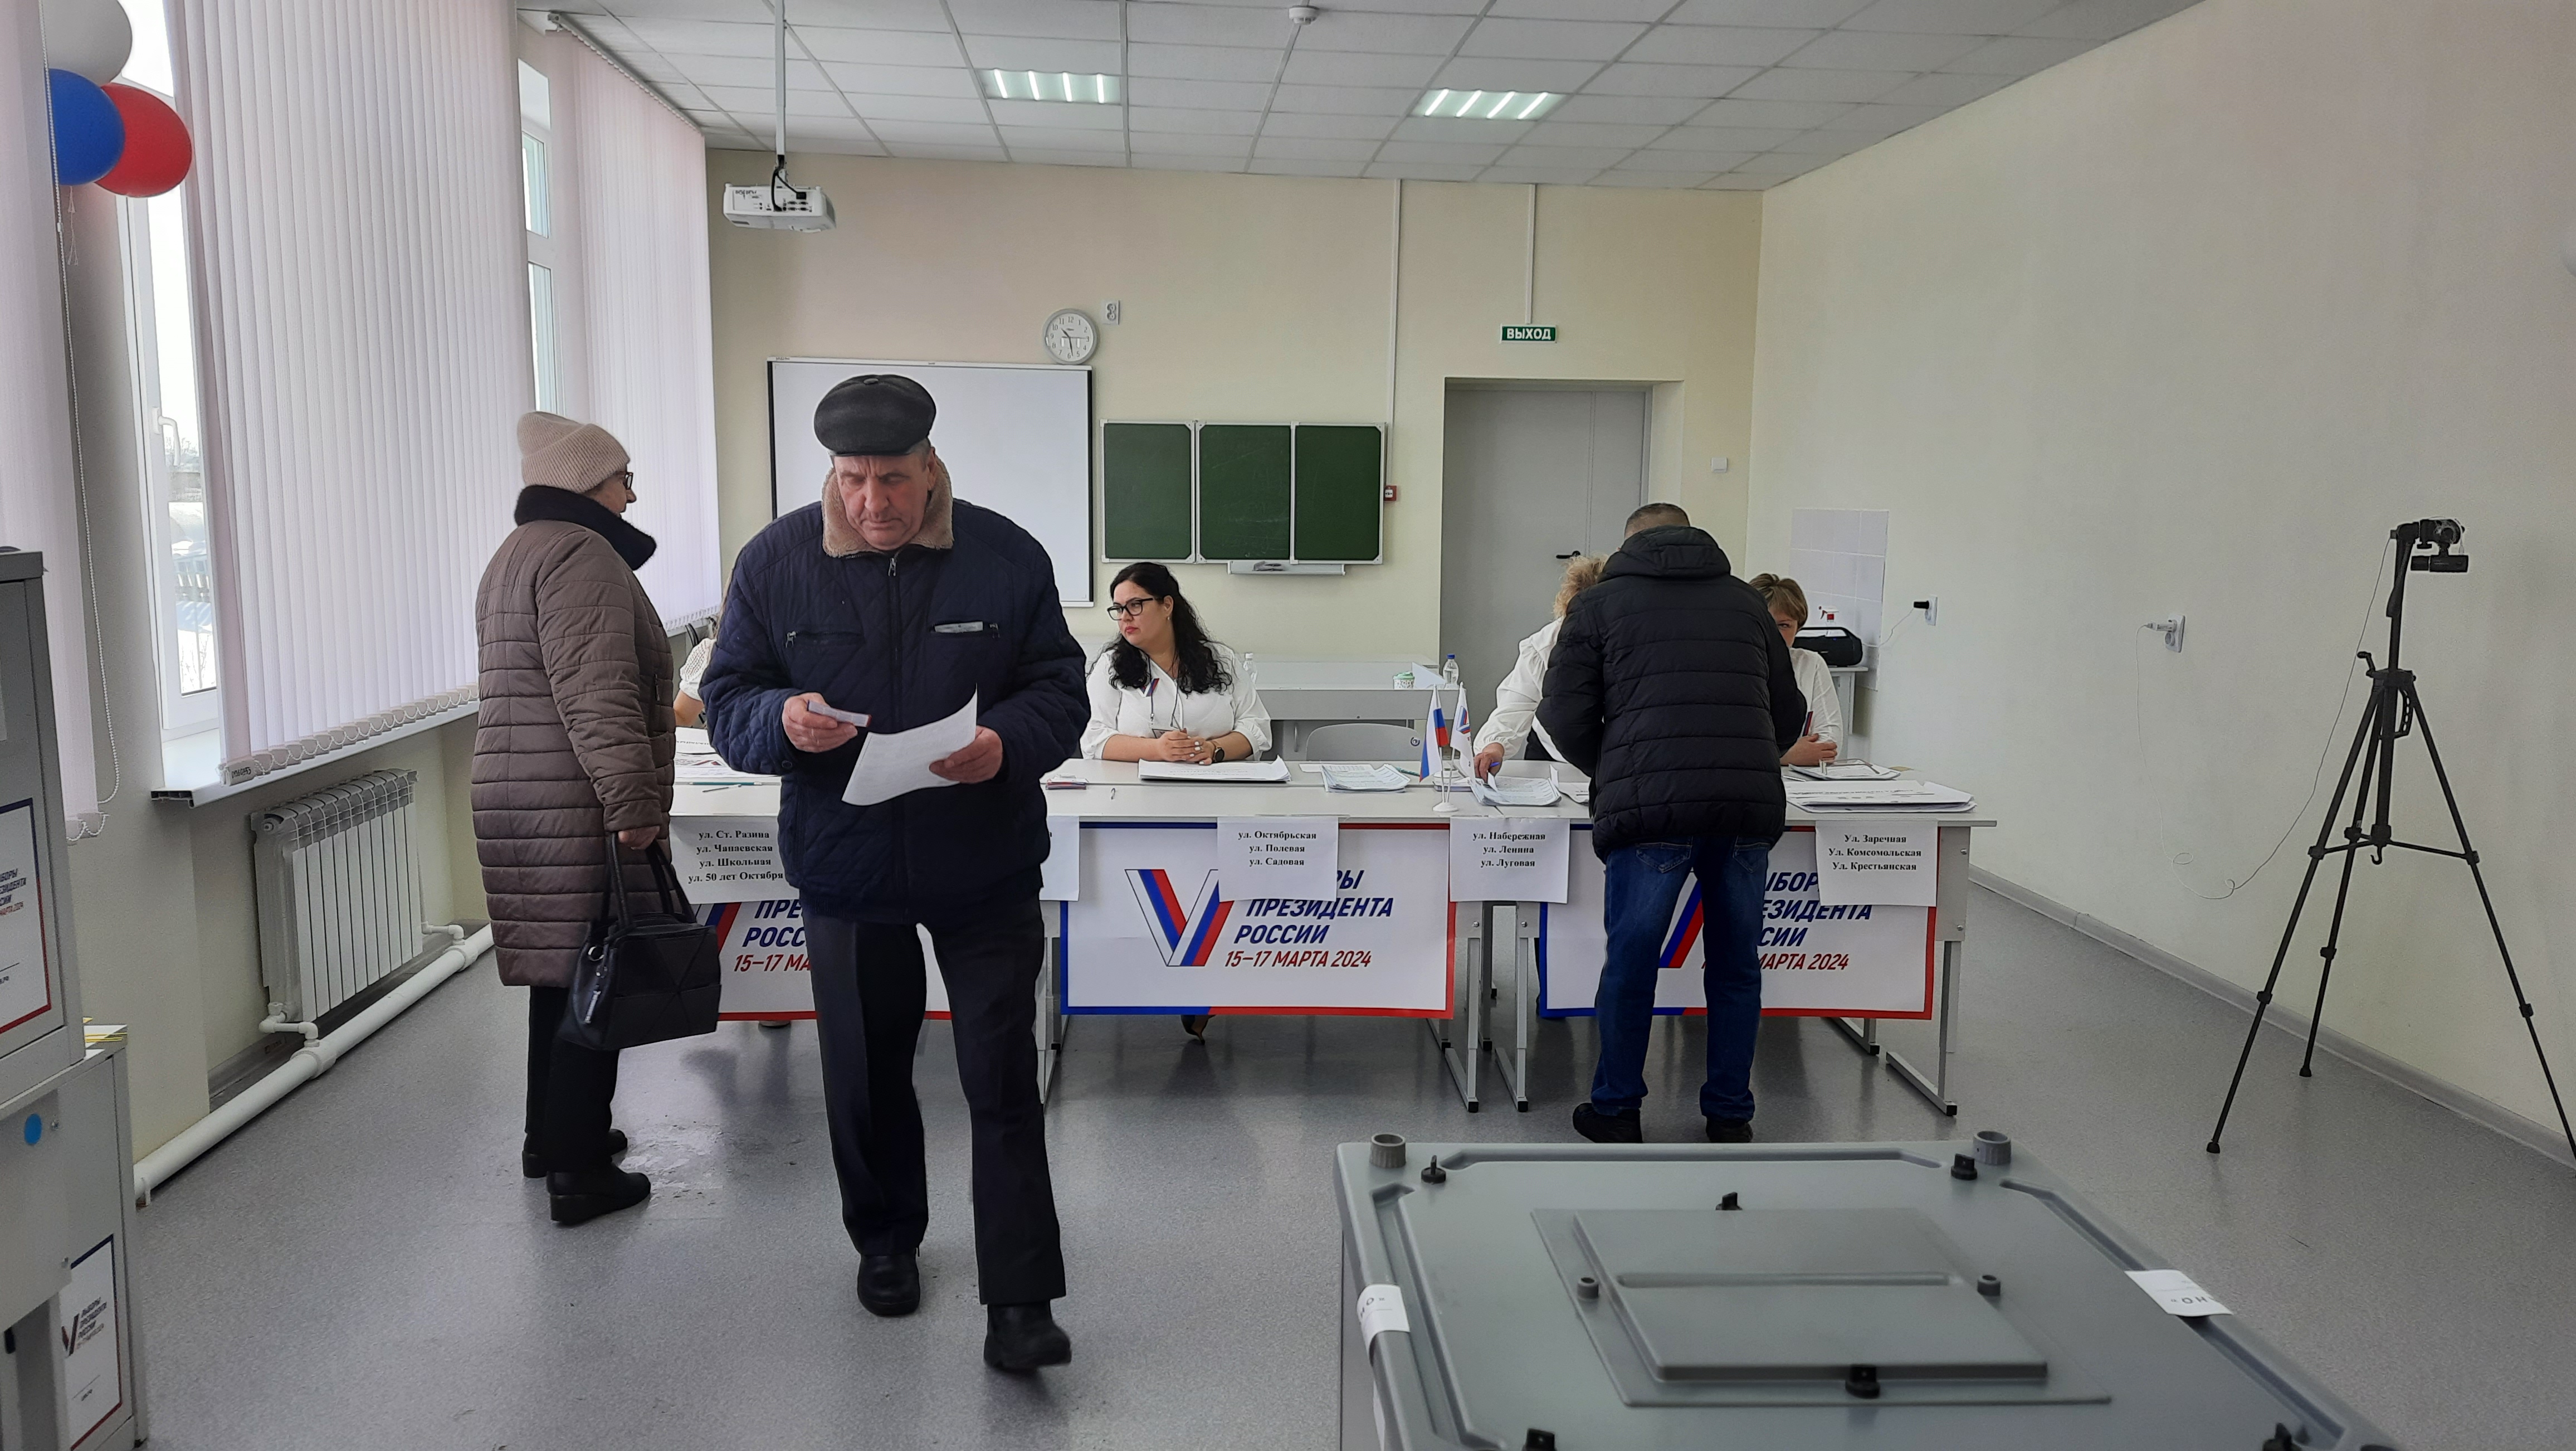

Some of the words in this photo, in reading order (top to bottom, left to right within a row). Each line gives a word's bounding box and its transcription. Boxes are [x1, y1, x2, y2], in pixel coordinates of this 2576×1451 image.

[1506, 328, 1552, 340] ВЫХОД
[699, 832, 713, 841] ул.
[1238, 832, 1251, 840] ул.
[1255, 831, 1317, 840] Октябрьская
[1472, 832, 1486, 841] ул.
[1489, 831, 1545, 842] Набережная
[1862, 835, 1906, 844] Заречная
[696, 846, 711, 855] ул.
[1249, 845, 1262, 854] ул.
[1266, 844, 1305, 853] Полевая
[1483, 846, 1496, 855] ул.
[1499, 845, 1534, 854] Ленина
[1847, 848, 1921, 856] Комсомольская
[699, 860, 714, 869] ул.
[718, 858, 771, 866] Школьная
[1249, 859, 1262, 867] ул.
[1265, 858, 1304, 866] Садовая
[1481, 860, 1494, 868] ул.
[1496, 859, 1535, 869] Луговая
[1851, 862, 1916, 871] Крестьянская
[688, 875, 702, 884] ул.
[739, 871, 783, 880] Октября
[1246, 898, 1393, 919] ПРЕЗИДЕНТА
[1763, 900, 1872, 922] ЕЗИДЕНТА
[742, 927, 806, 947] РОСС
[1233, 925, 1330, 944] РОССИИ
[1757, 927, 1808, 947] СИИ
[1272, 951, 1329, 967] МАРТА
[1330, 951, 1372, 967] 2024
[1807, 953, 1850, 970] 2024
